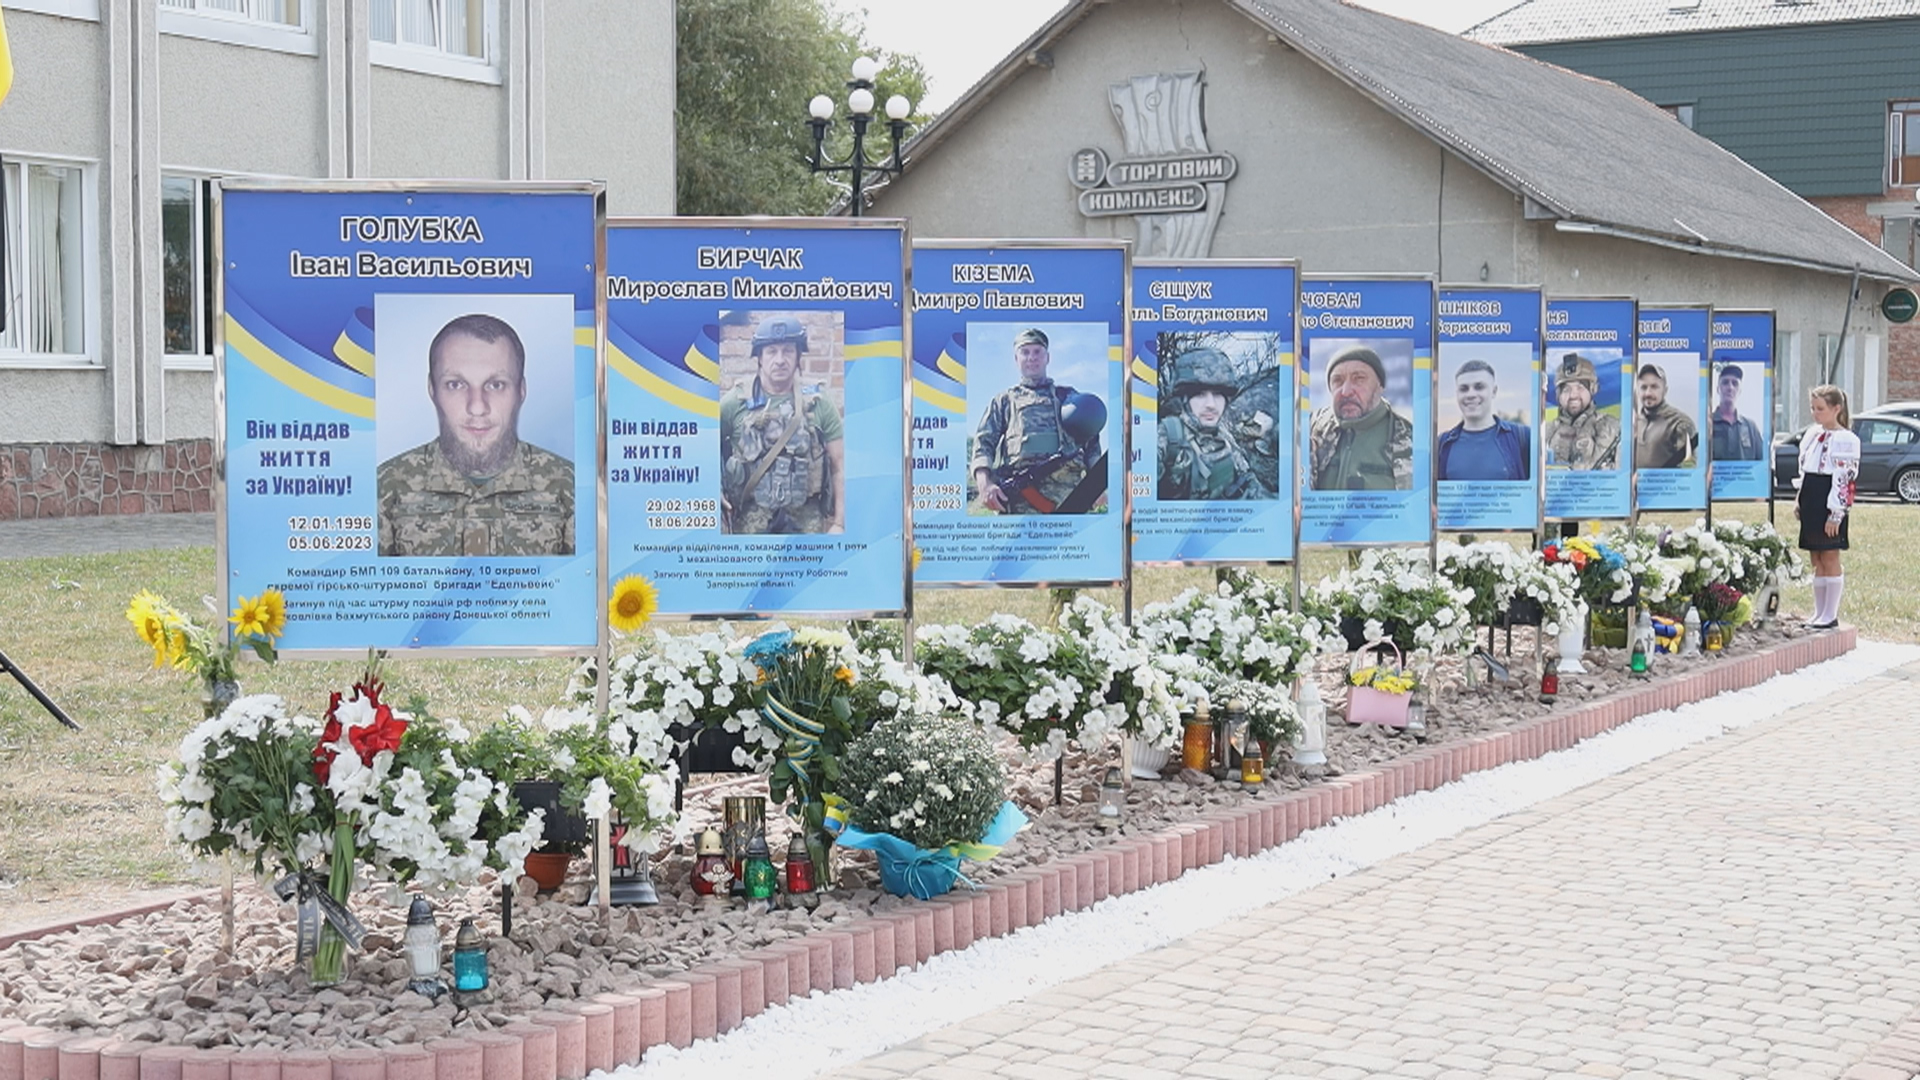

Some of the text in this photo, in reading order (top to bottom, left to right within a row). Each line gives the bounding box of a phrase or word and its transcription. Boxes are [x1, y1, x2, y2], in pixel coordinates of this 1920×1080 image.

[1089, 188, 1196, 210] КОМПЛЕКС
[341, 216, 483, 243] ГОЛУБКА
[290, 250, 532, 278] Іван Васильович
[697, 246, 804, 270] БИРЧАК
[953, 263, 1035, 284] КІЗЕМА
[607, 275, 893, 303] Мирослав Миколайович
[1149, 281, 1213, 301] СІЩУК
[983, 288, 1084, 310] Павлович
[1301, 292, 1361, 309] ЧОБАН
[1162, 304, 1268, 324] Богданович
[1320, 312, 1414, 329] Степанович
[246, 420, 350, 442] Він віддав
[612, 419, 698, 437] Він віддав
[260, 450, 331, 468] життя
[623, 445, 682, 460] життя
[611, 465, 700, 484] за Україну!
[245, 474, 352, 497] за Україну!
[646, 500, 717, 513] 29.02.1968
[288, 516, 373, 532] 12.01.1996
[646, 516, 717, 529] 18.06.2023
[1039, 521, 1073, 530] окремої
[288, 536, 373, 550] 05.06.2023
[633, 542, 868, 553] Командир відділення, командир машини 1 роти
[686, 554, 763, 563] механізованого
[766, 554, 824, 565] батальйону
[287, 565, 541, 580] Командир БМП 109 батальйону, 10 окремої
[654, 570, 690, 580] Загинув
[694, 569, 713, 579] біля
[774, 569, 804, 580] пункту
[317, 580, 427, 592] гірсько-штурмової
[434, 580, 482, 591] бригади
[283, 600, 325, 610] Загинув
[329, 599, 345, 609] під
[348, 600, 366, 608] час
[369, 600, 410, 610] штурму
[412, 598, 454, 608] позицій
[457, 598, 473, 608] рф
[475, 598, 519, 608] поблизу
[336, 611, 410, 622] Бахмутського
[413, 610, 450, 621] району
[453, 610, 508, 621] Донецької
[511, 609, 551, 619] області
